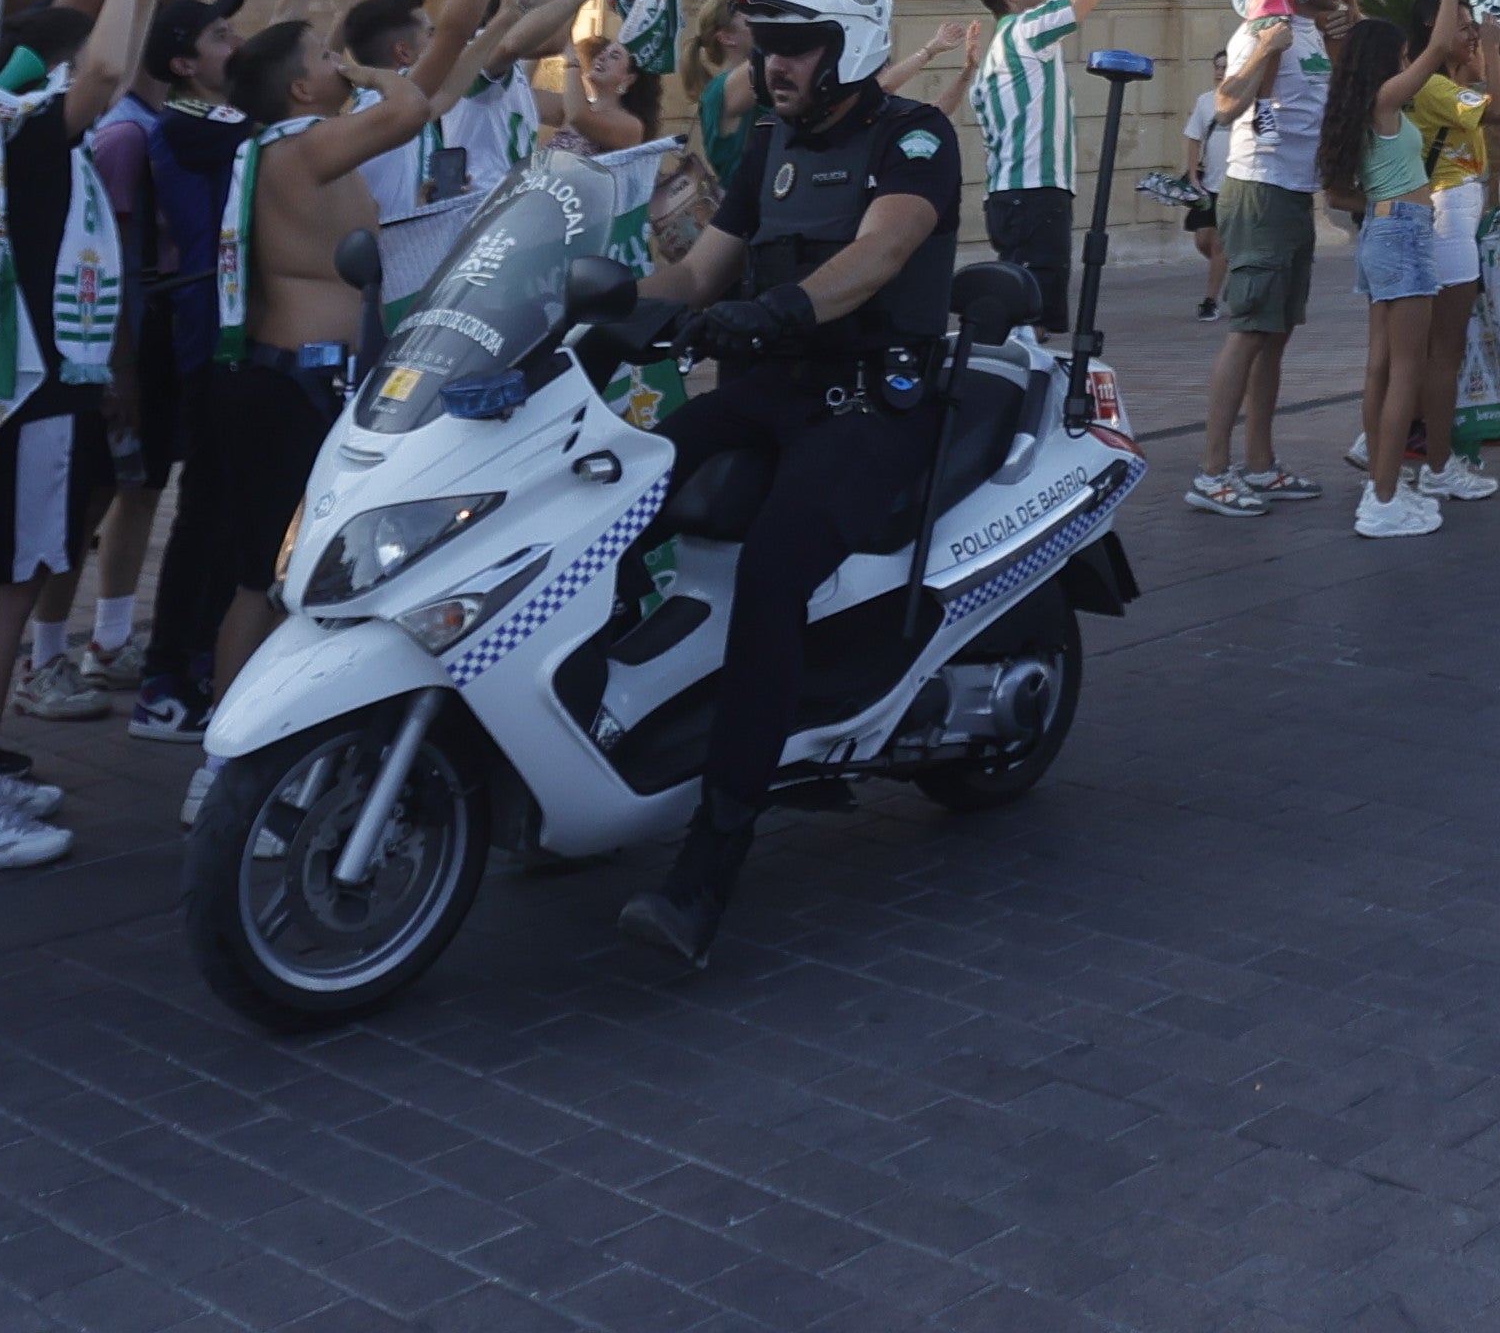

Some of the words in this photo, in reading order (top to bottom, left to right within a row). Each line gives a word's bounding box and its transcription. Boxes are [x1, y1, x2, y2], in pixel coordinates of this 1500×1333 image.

[547, 177, 585, 246] LOCAL
[950, 513, 1018, 564] POLICIA
[1016, 499, 1039, 526] DE
[1037, 466, 1088, 512] BARRIO
